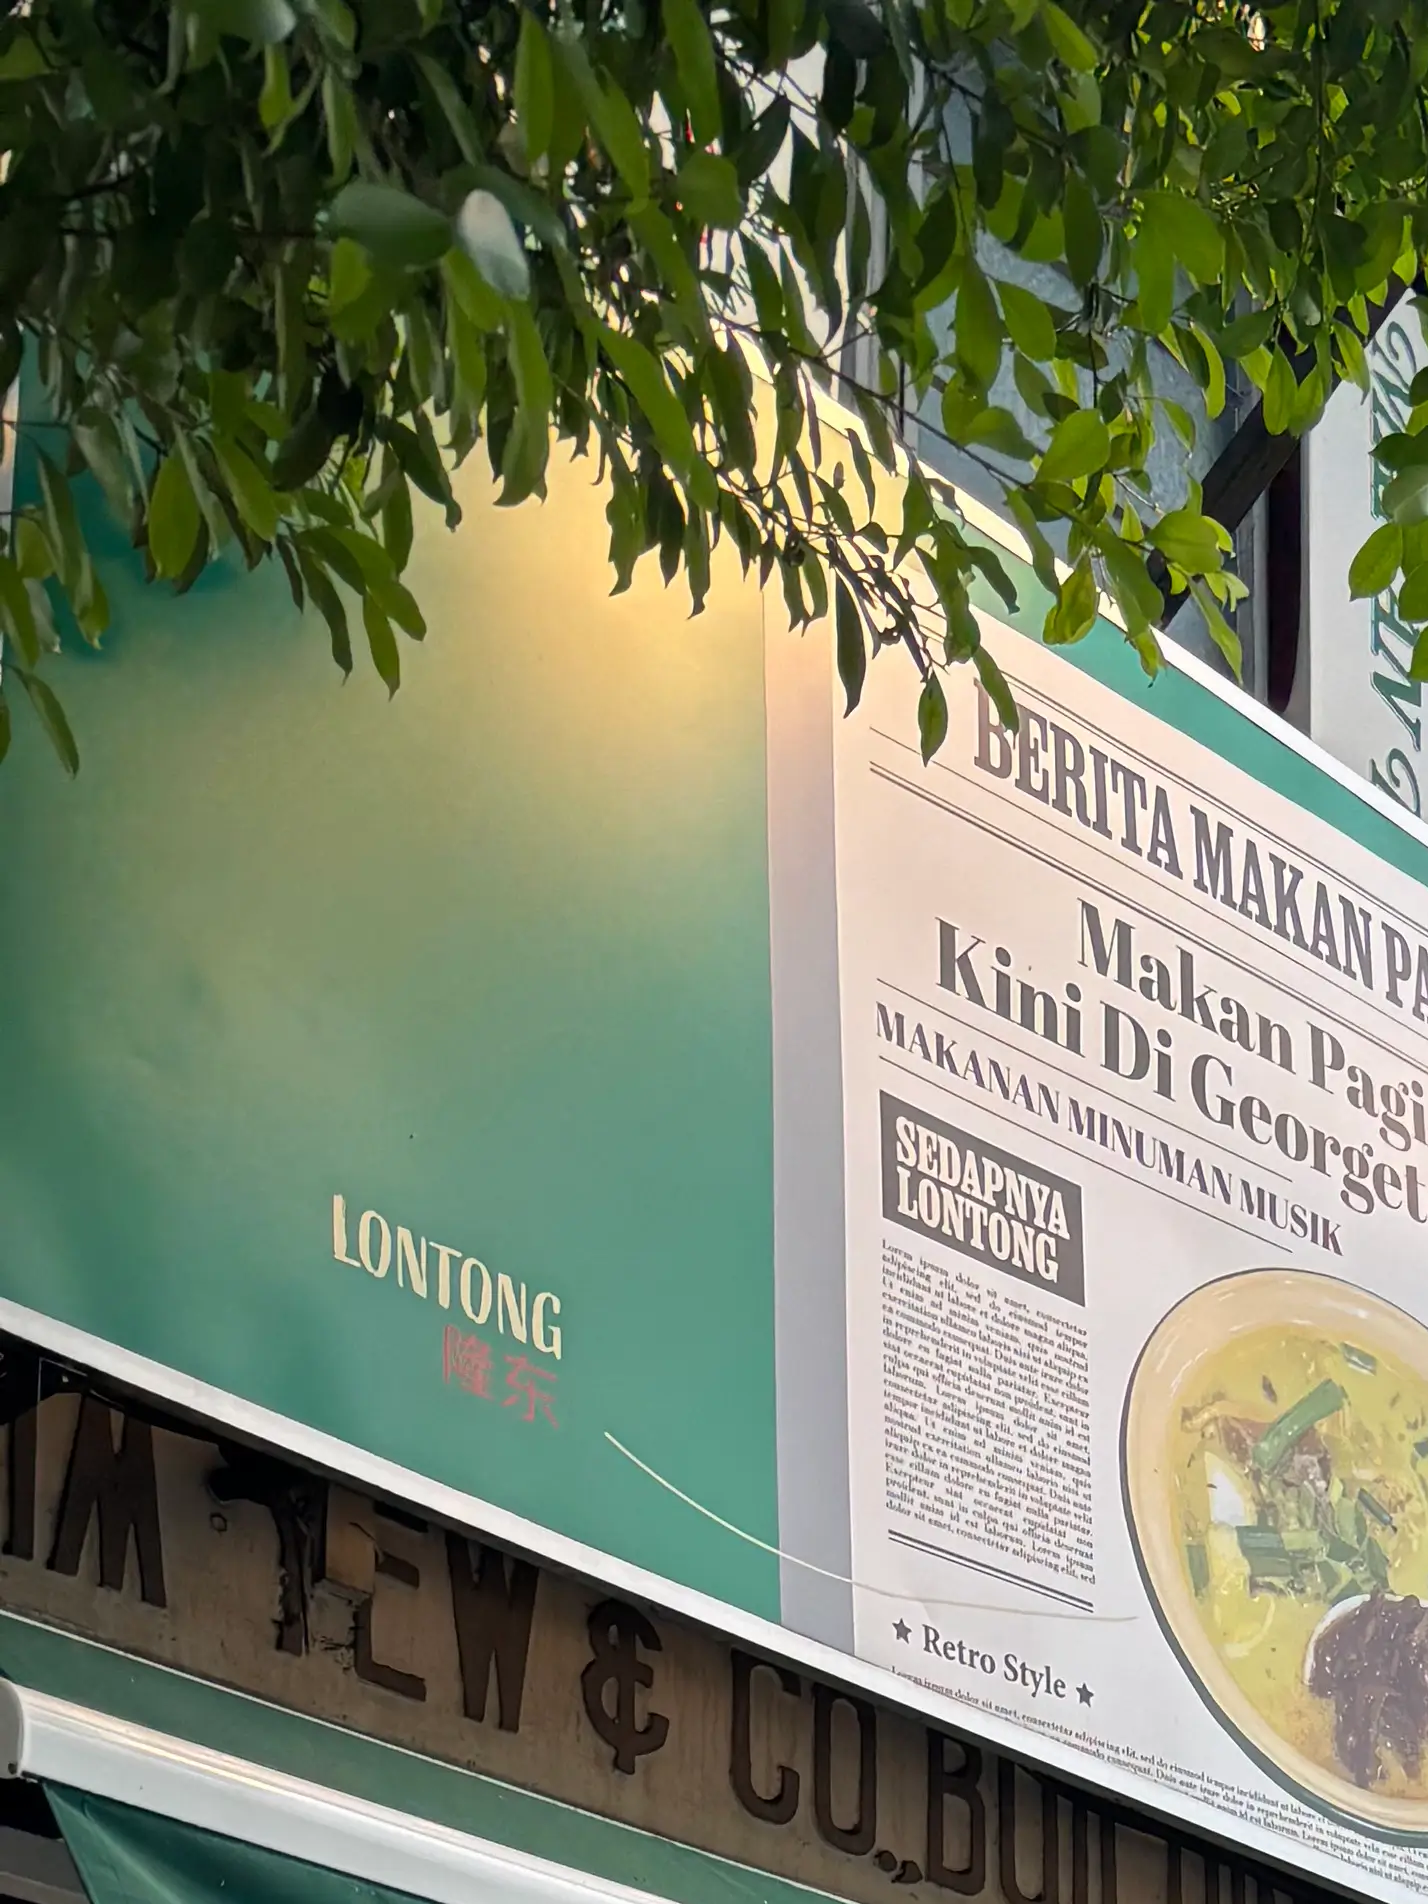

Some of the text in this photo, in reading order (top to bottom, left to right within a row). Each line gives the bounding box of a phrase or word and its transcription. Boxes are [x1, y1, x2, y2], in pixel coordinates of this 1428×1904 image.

[974, 679, 1183, 881] BERITA
[1192, 804, 1375, 988] MAKAN
[936, 918, 1083, 1057] Kini
[1101, 1001, 1173, 1101] Di
[1078, 899, 1428, 1150] Makan Pagi
[876, 1003, 1344, 1256] MAKANAN MINUMAN MUSIK
[895, 1115, 1071, 1240] SEDAPNYA
[332, 1194, 562, 1360] LONTONG
[897, 1151, 1060, 1284] LONTONG
[922, 1624, 1068, 1700] Retro Style
